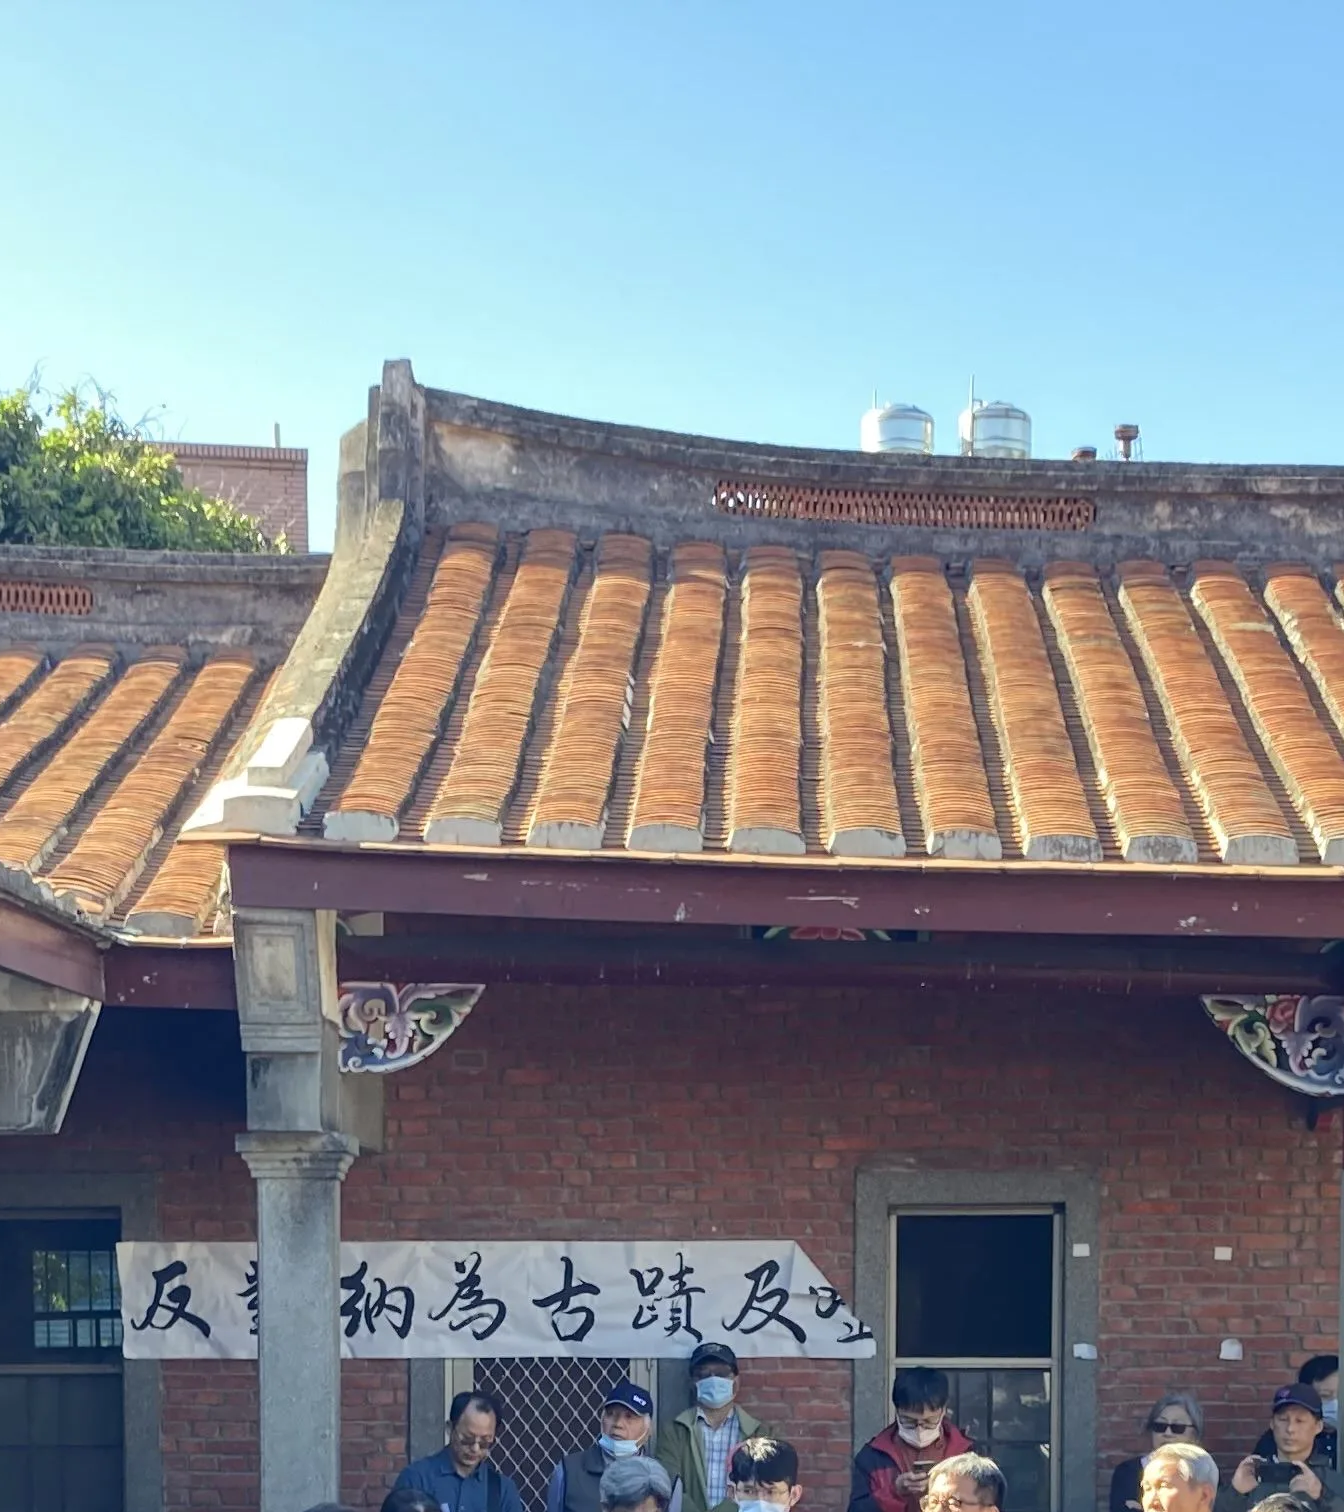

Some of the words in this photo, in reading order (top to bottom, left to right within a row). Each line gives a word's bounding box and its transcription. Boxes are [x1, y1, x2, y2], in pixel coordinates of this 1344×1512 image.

[130, 1250, 874, 1344] 反納為古蹟及
